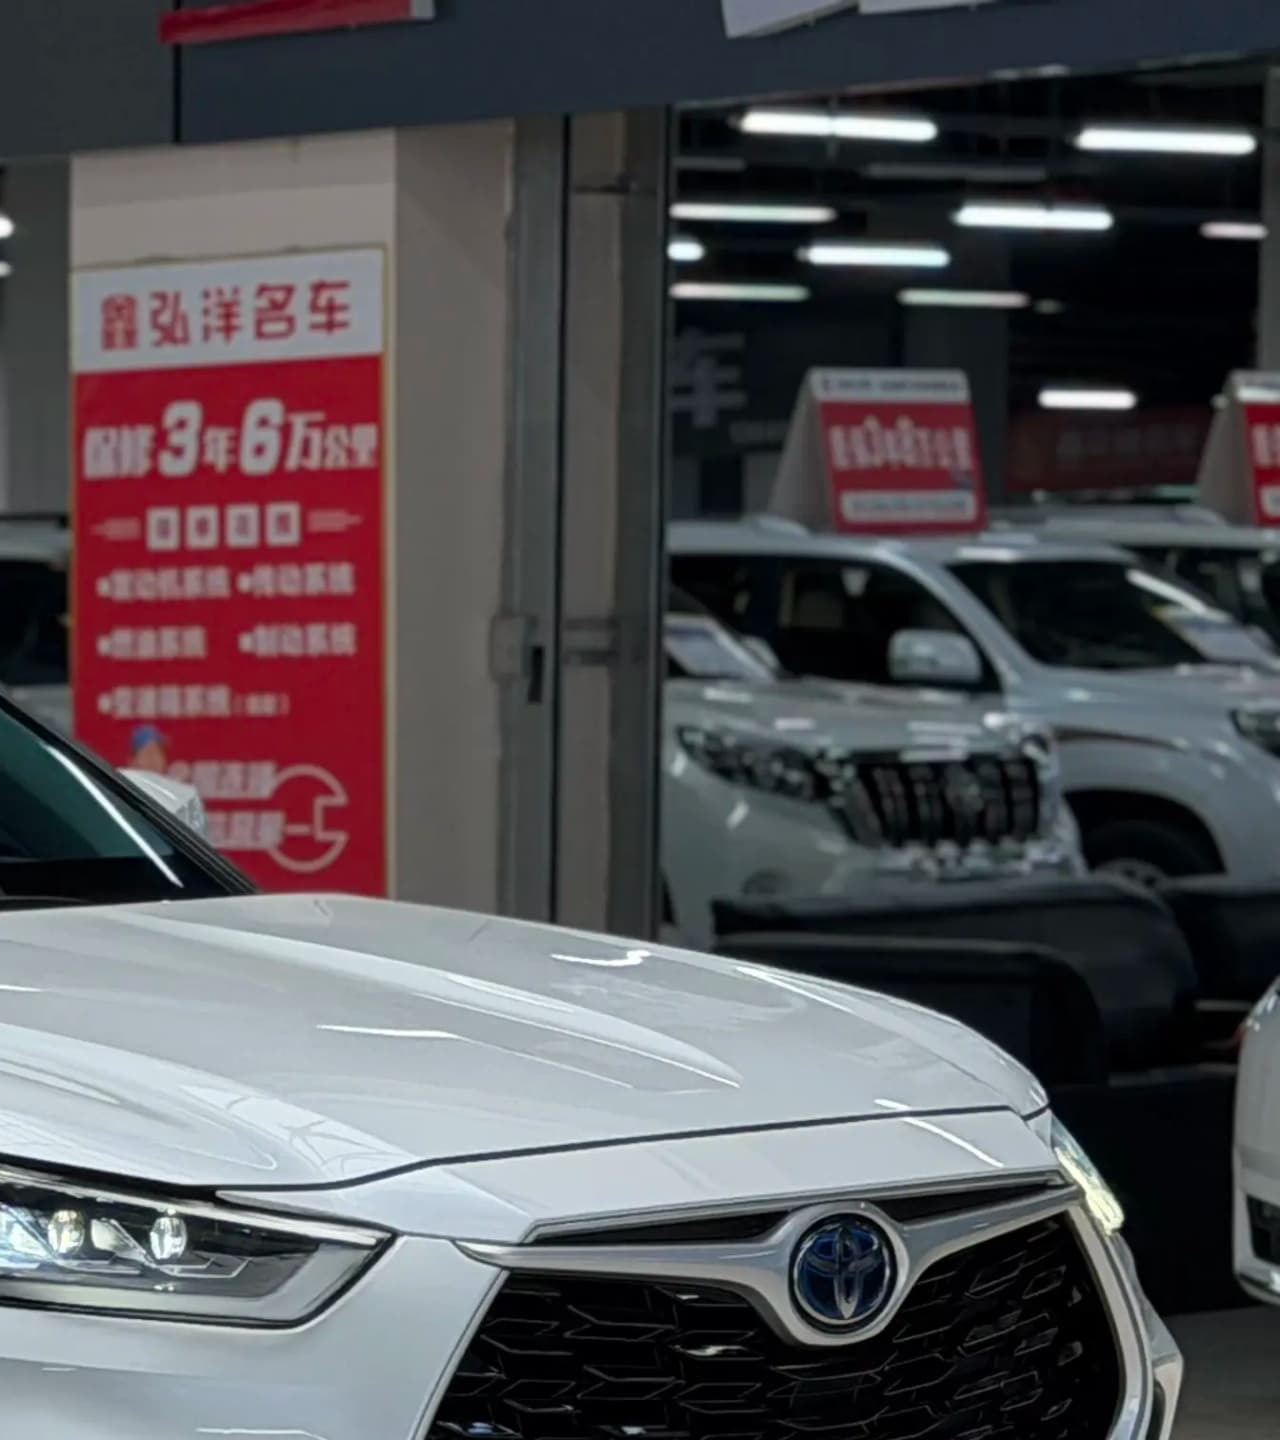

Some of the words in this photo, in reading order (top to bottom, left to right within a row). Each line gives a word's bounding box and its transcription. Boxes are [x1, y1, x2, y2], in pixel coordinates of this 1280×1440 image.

[101, 280, 350, 352] 鑫弘洋名车
[83, 398, 378, 480] 保修3年6万公里
